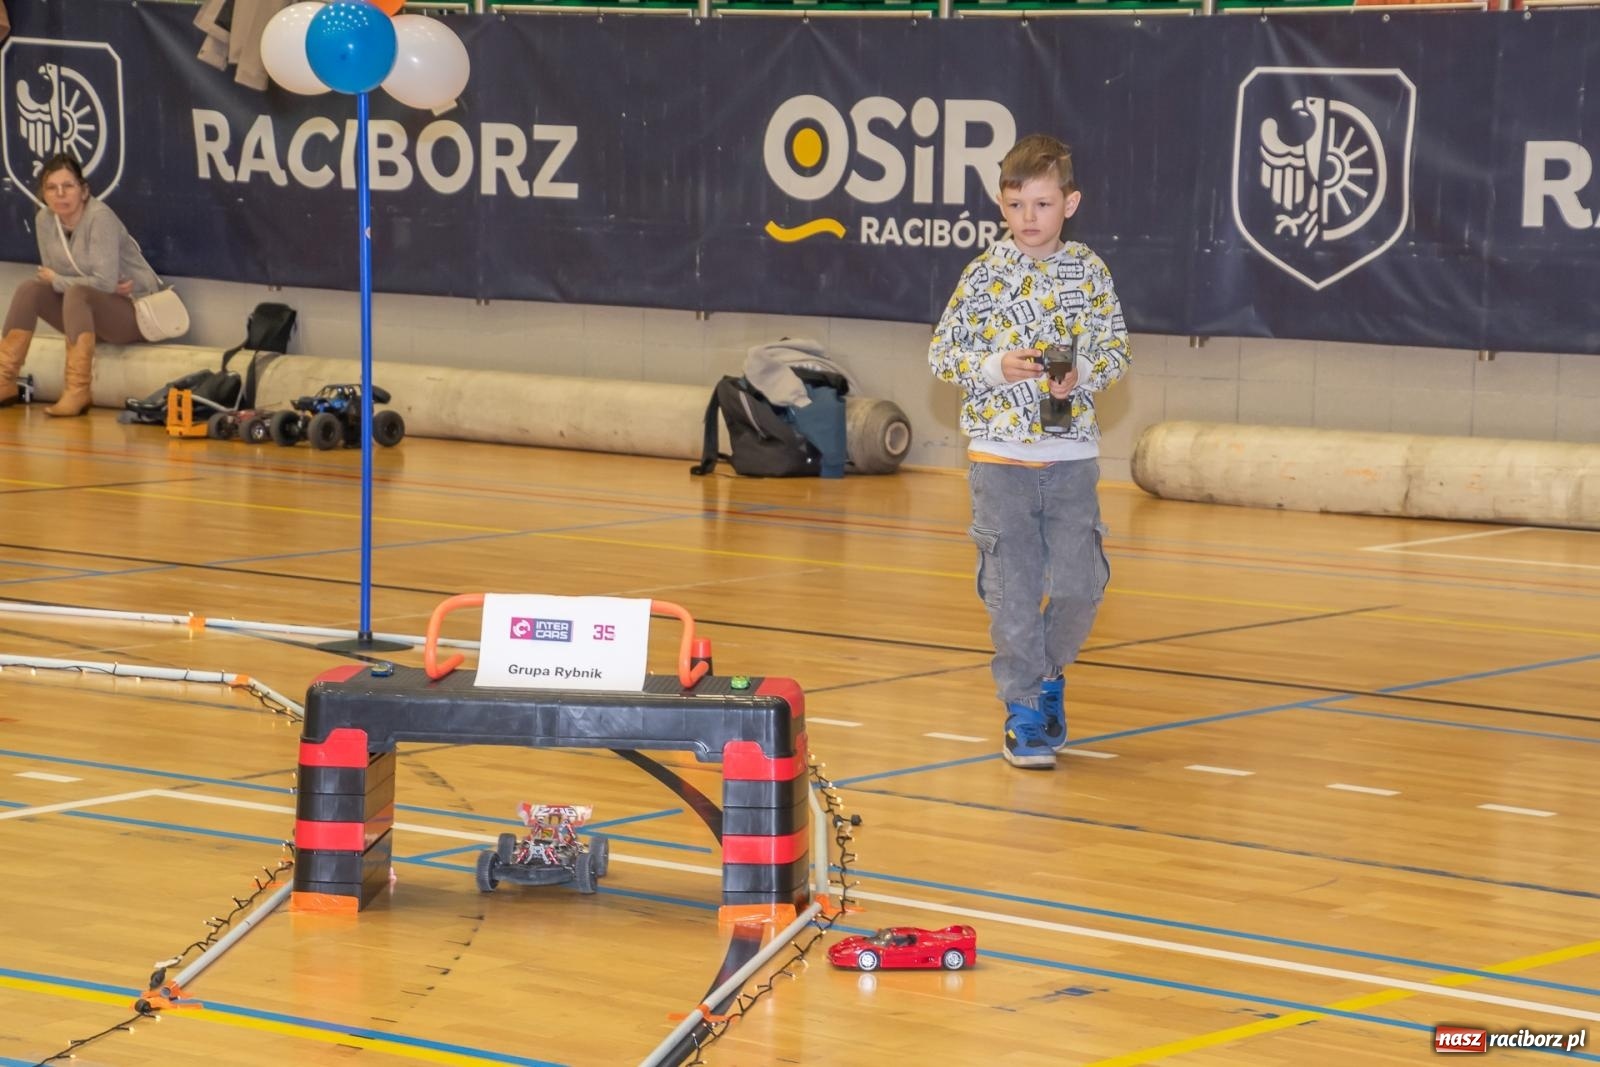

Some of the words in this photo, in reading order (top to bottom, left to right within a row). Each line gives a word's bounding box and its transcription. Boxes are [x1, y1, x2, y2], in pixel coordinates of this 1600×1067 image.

[1522, 140, 1600, 230] R
[535, 621, 569, 631] INTER
[593, 624, 615, 641] 35
[535, 630, 568, 640] CARS
[508, 664, 550, 677] Grupa
[554, 667, 602, 679] Rybnik
